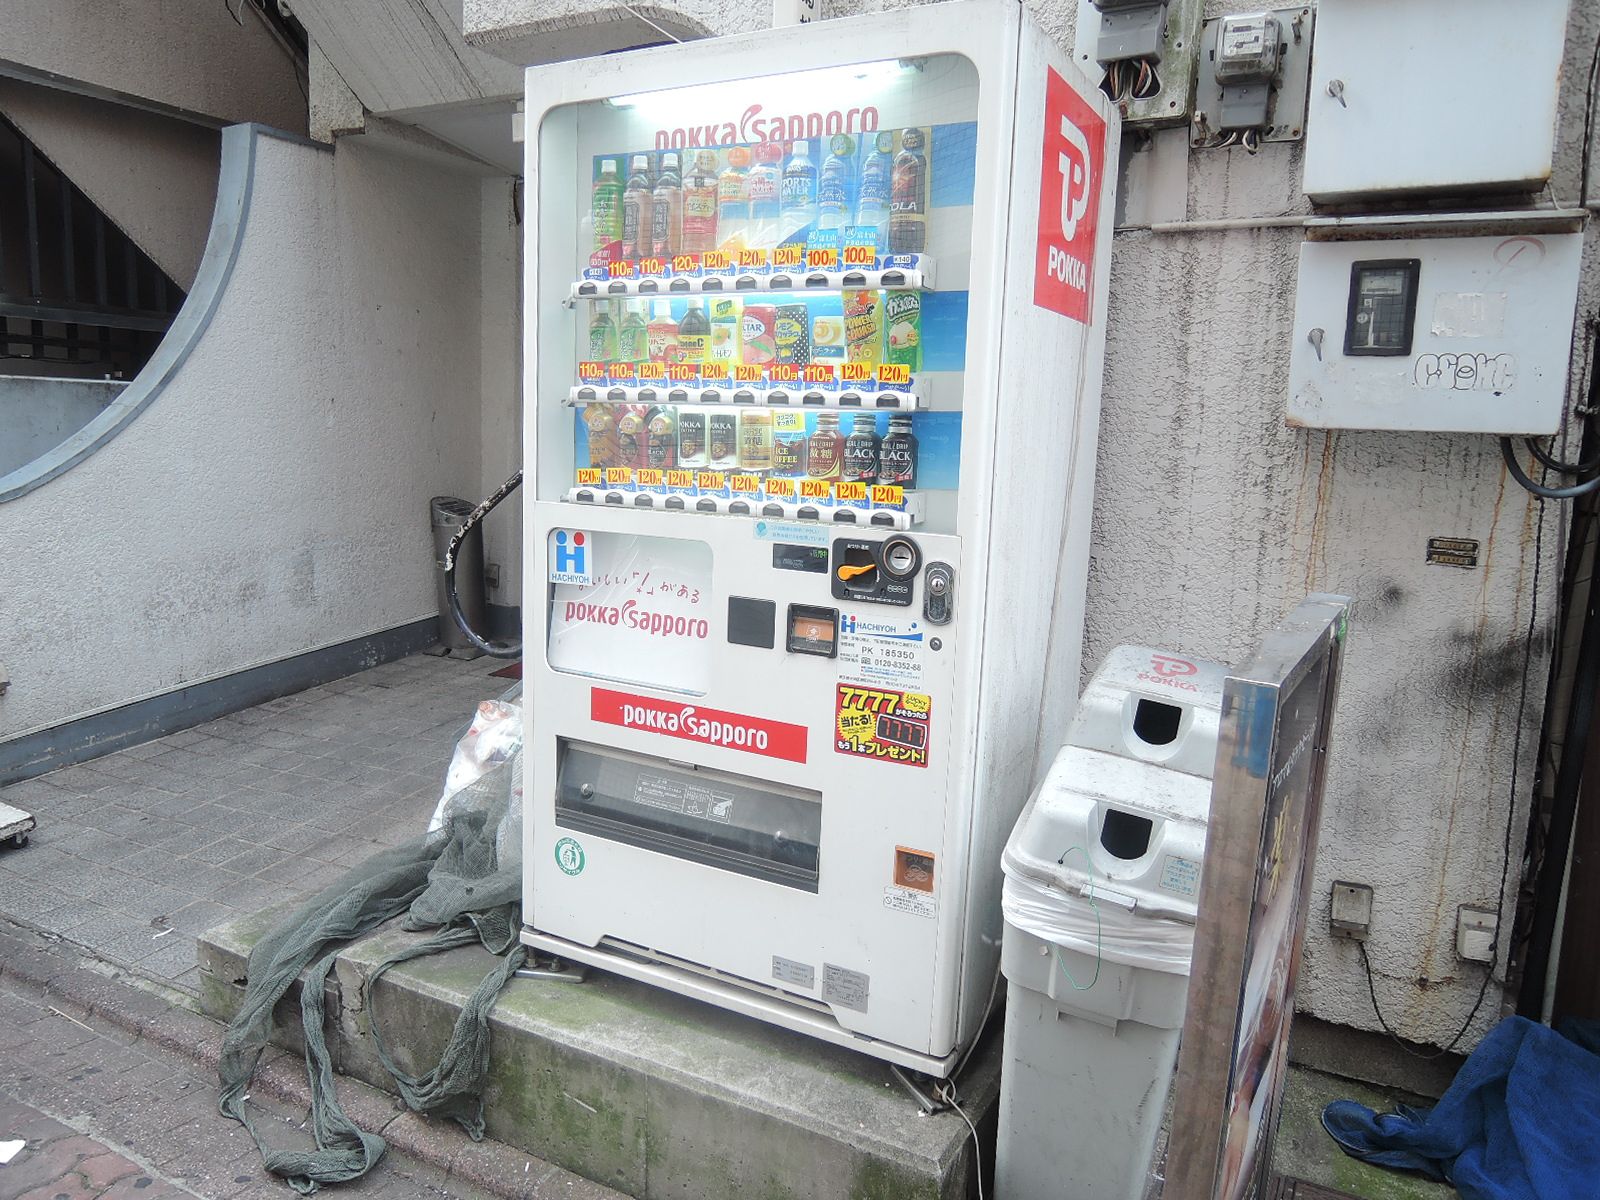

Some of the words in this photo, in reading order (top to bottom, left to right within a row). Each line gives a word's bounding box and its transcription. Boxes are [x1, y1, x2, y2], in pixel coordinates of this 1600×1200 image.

[781, 177, 811, 187] PORTS
[1047, 245, 1086, 292] POKKA
[775, 455, 798, 463] OFFEE
[551, 574, 590, 584] HACHIYOH
[856, 622, 897, 633] HACHIYOH
[861, 647, 874, 655] PK
[880, 649, 915, 660] 185350
[839, 687, 900, 714] 7777
[841, 714, 873, 728] 当たる!
